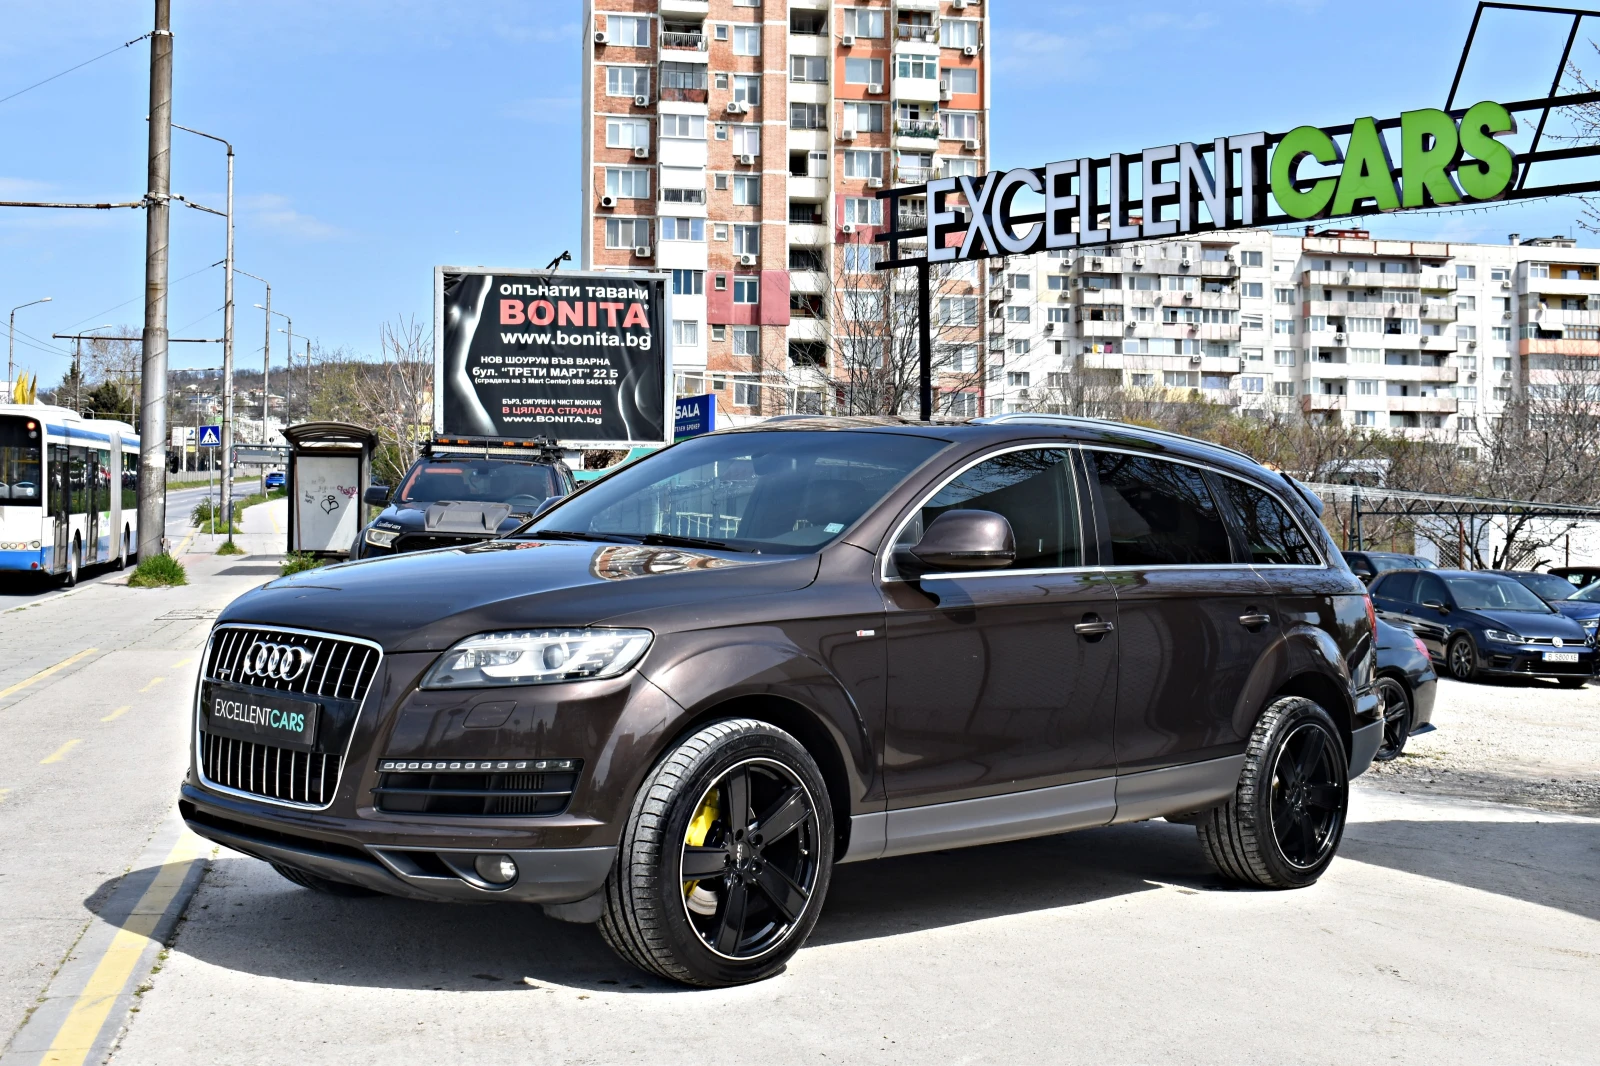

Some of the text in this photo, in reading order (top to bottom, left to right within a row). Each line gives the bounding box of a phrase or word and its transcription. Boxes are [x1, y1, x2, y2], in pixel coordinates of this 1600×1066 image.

[927, 101, 1516, 262] EXCELLENTCARS
[500, 284, 649, 299] опънати тавани
[500, 299, 650, 328] BONITA
[501, 331, 652, 350] www.bonita.bg
[481, 356, 610, 366] НОВ ШОУРУМ ВЪВ ВАРНА
[472, 367, 498, 377] бул.
[593, 369, 607, 378] 22
[610, 369, 618, 378] Б
[545, 378, 571, 386] Center)
[512, 407, 555, 415] ЦЯЛАТА
[557, 407, 602, 415] СТРАНА!
[503, 416, 602, 424] www.BONITA.bg
[214, 698, 305, 732] EXCELLENTCARS
